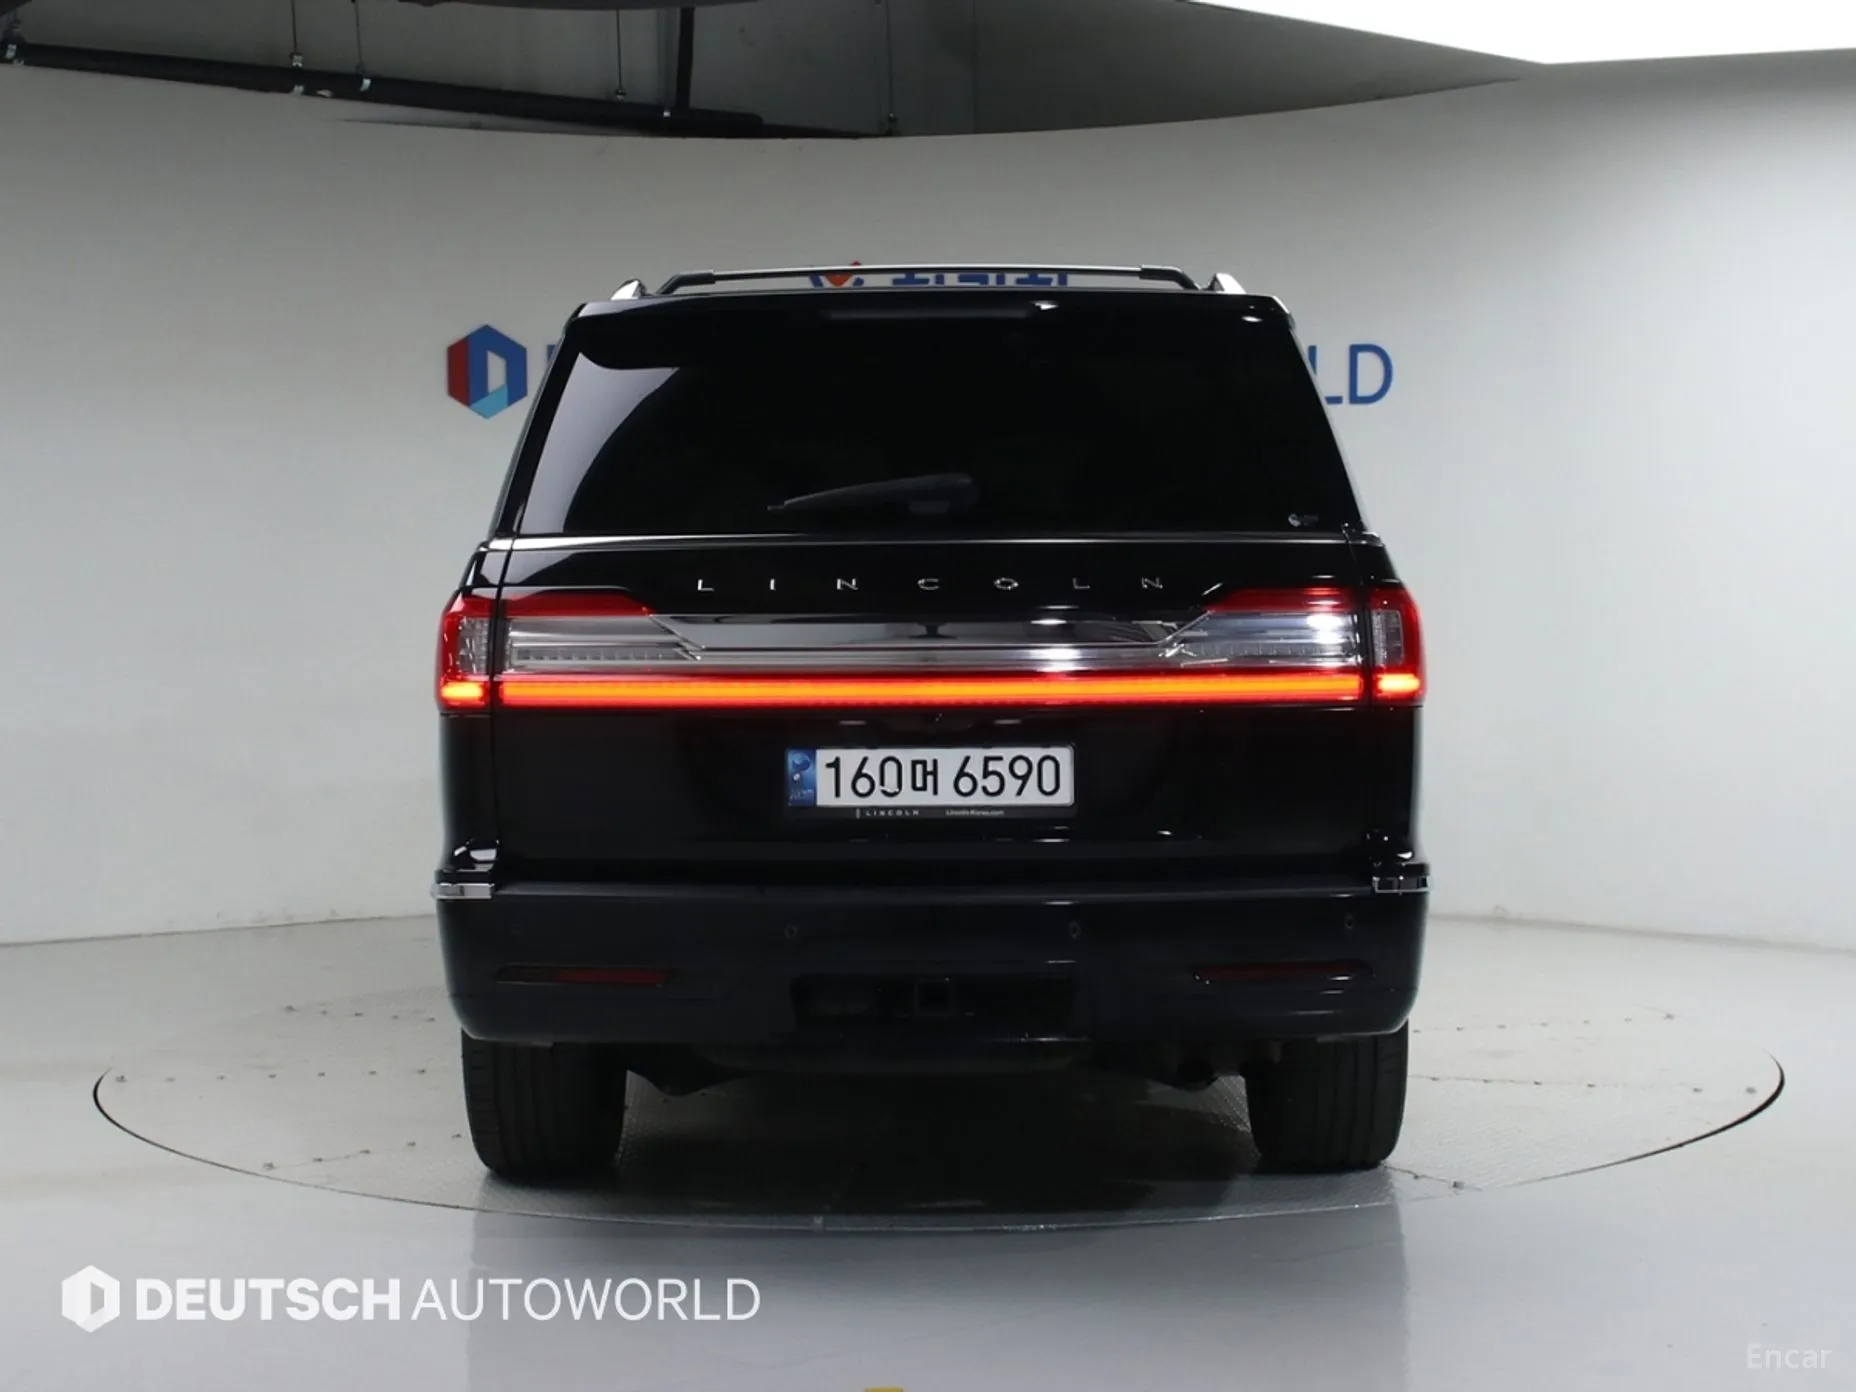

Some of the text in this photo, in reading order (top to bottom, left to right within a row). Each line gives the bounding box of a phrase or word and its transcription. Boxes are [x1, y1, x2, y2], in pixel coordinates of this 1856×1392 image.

[697, 576, 1164, 592] LINCOLN
[825, 754, 1062, 799] 160머 6590
